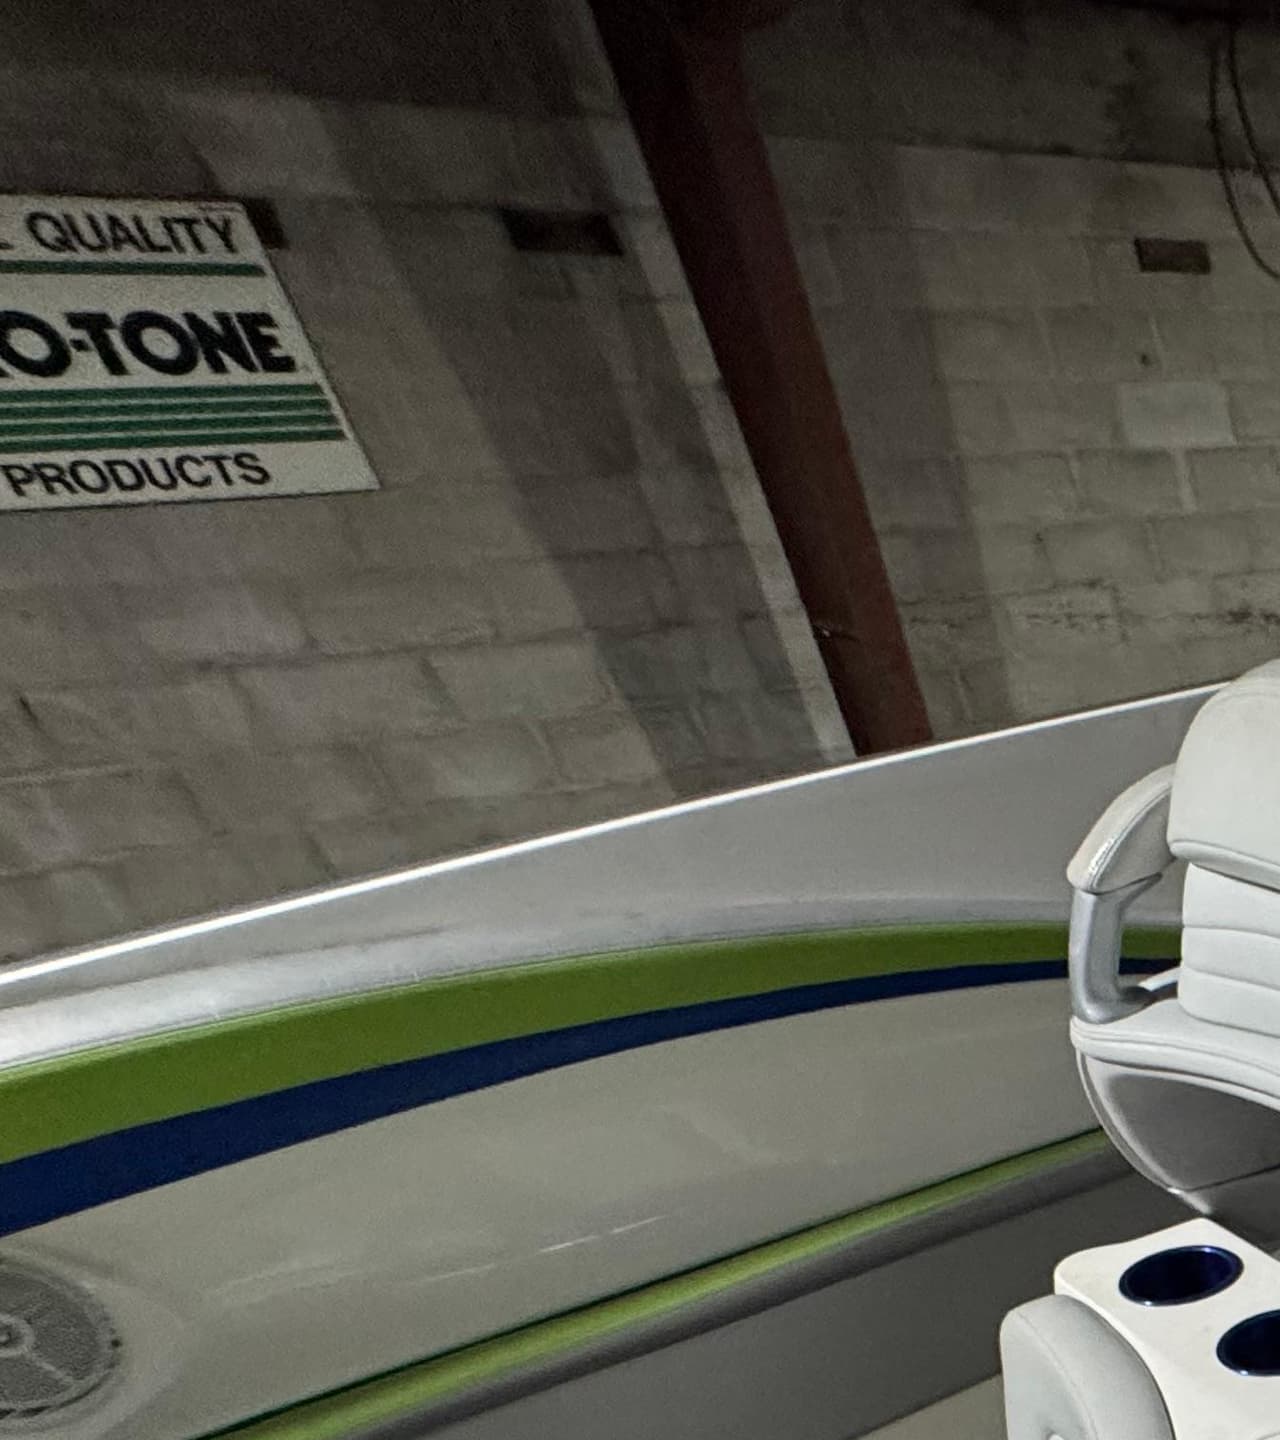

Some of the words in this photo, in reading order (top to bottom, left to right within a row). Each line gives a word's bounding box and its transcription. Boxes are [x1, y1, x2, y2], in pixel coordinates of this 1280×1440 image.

[25, 211, 237, 253] QUALITY
[0, 310, 297, 378] O-TONE
[0, 453, 271, 497] PRODUCTS
